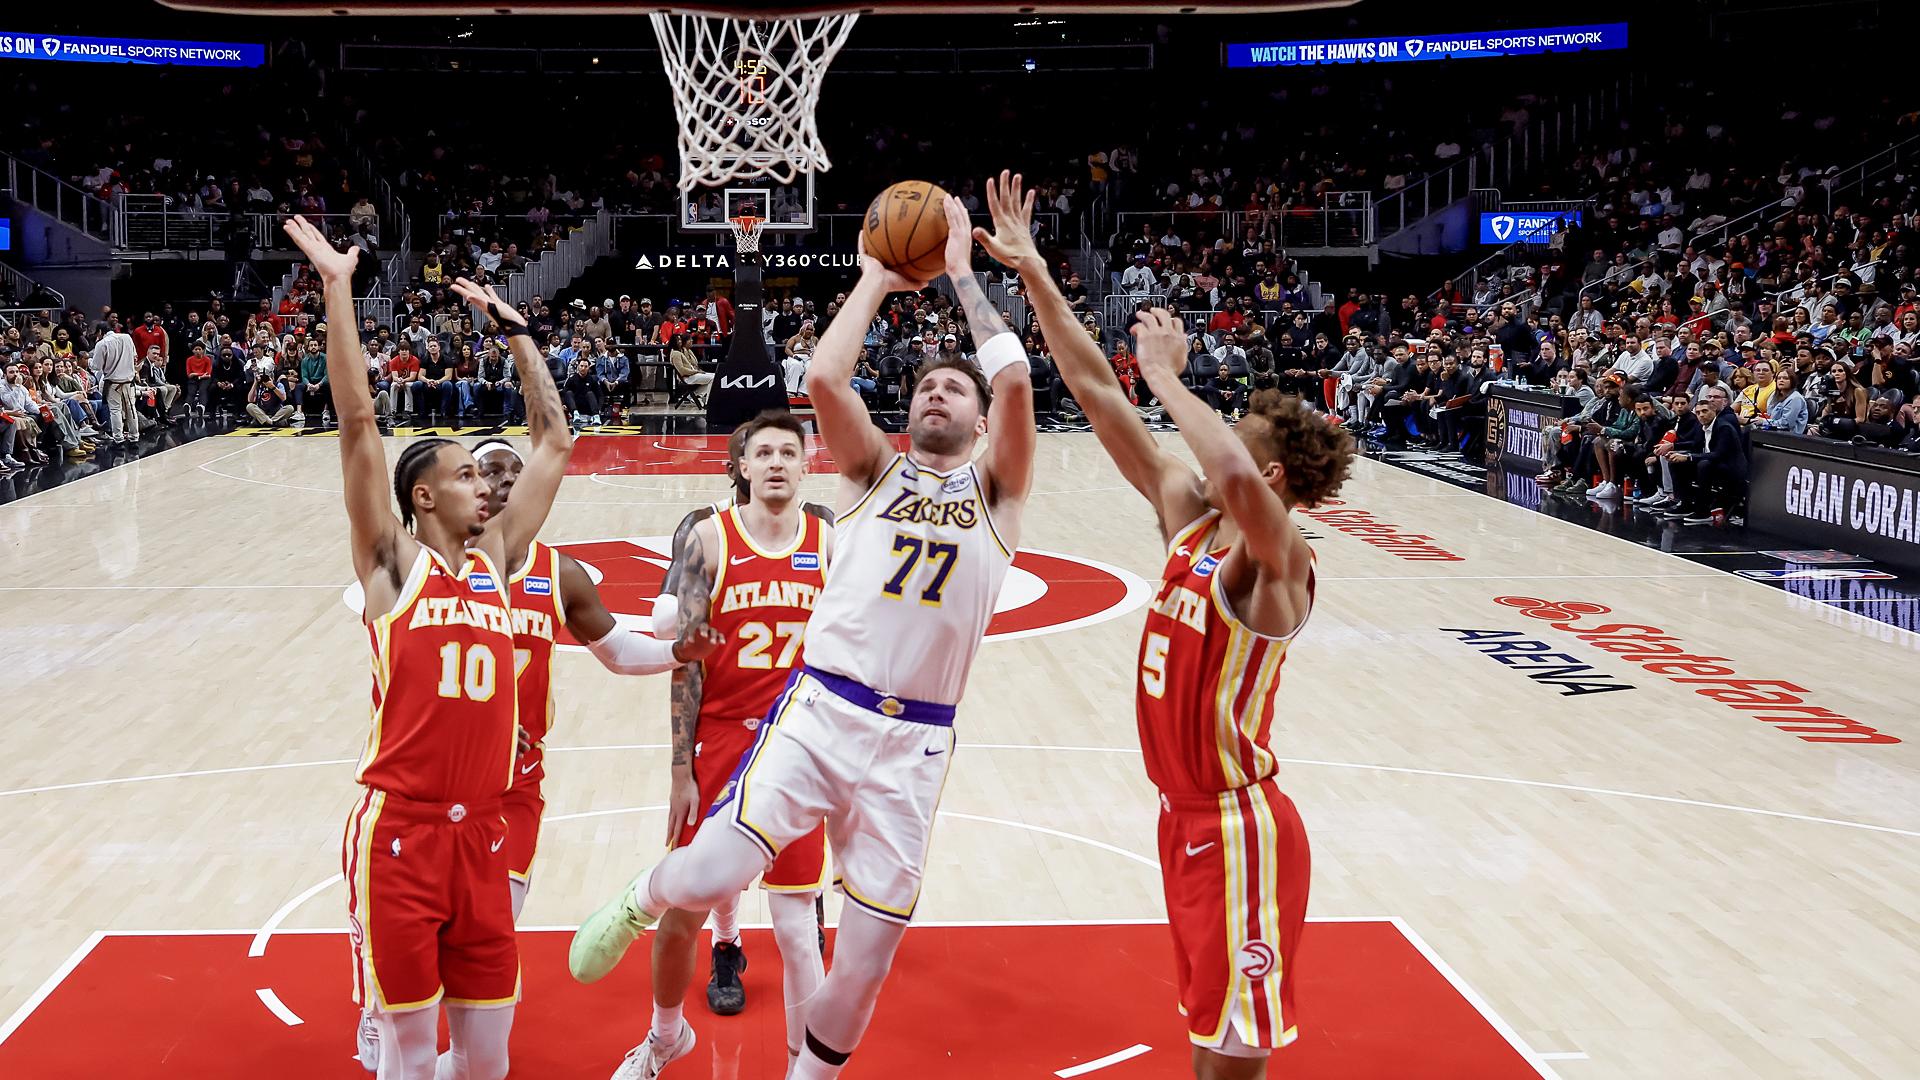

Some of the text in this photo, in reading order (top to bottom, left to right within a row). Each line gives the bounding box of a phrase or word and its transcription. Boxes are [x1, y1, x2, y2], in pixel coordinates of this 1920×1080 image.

[15, 38, 35, 54] ON
[63, 43, 126, 56] FANDUEL
[127, 46, 177, 58] SPORTS
[180, 48, 241, 60] NETWORK
[734, 60, 767, 75] 4:55
[1250, 32, 1602, 62] WATCH THE HAWKS ON FANDUEL SPORTS NETWORK
[659, 254, 729, 268] DELTA
[876, 486, 978, 530] LAKERS
[1785, 465, 1846, 526] GRAN
[880, 532, 960, 609] 77
[737, 621, 809, 670] 27
[1141, 631, 1171, 700] 5
[1438, 627, 1637, 697] ARENA
[437, 641, 497, 702] 10
